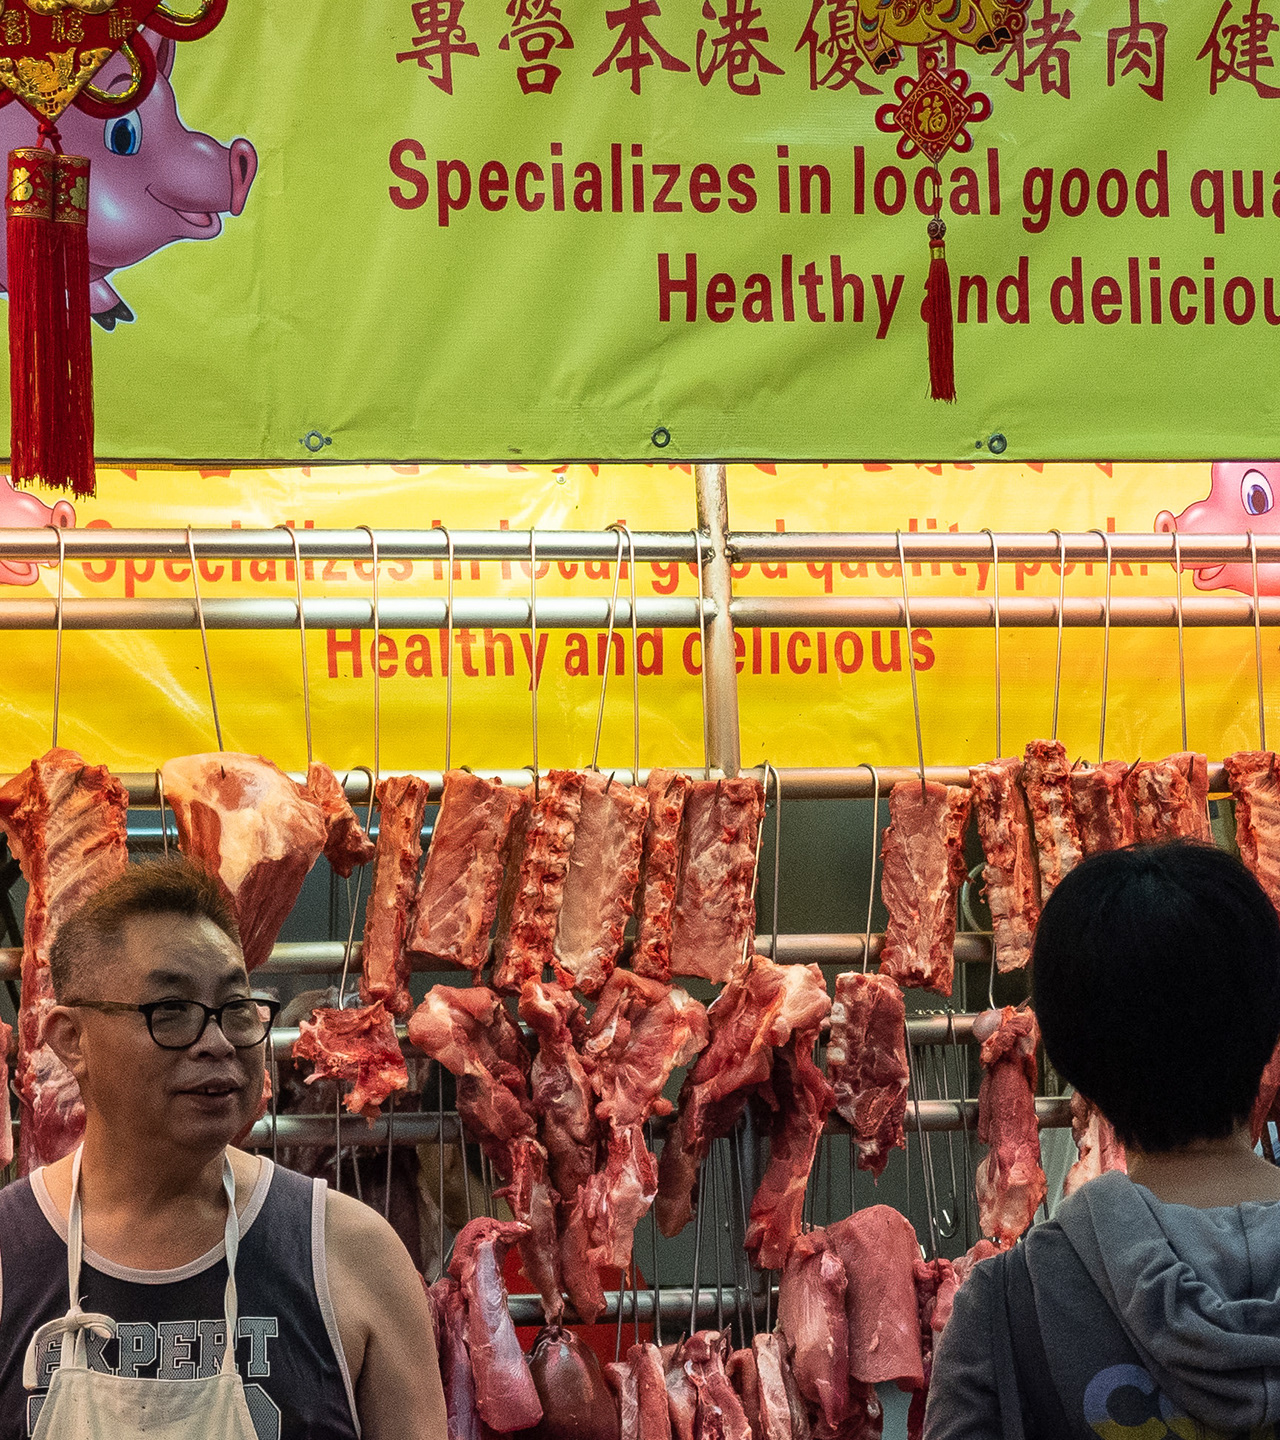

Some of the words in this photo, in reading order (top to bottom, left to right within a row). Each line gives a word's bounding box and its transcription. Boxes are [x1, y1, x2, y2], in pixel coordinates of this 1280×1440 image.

[388, 137, 758, 228] Specializes
[777, 144, 832, 215] in
[853, 145, 1002, 217] local
[1021, 149, 1171, 234] good
[656, 252, 906, 340] Healthy
[919, 255, 1031, 325] nd
[325, 628, 551, 691] Healthy
[563, 627, 665, 677] and
